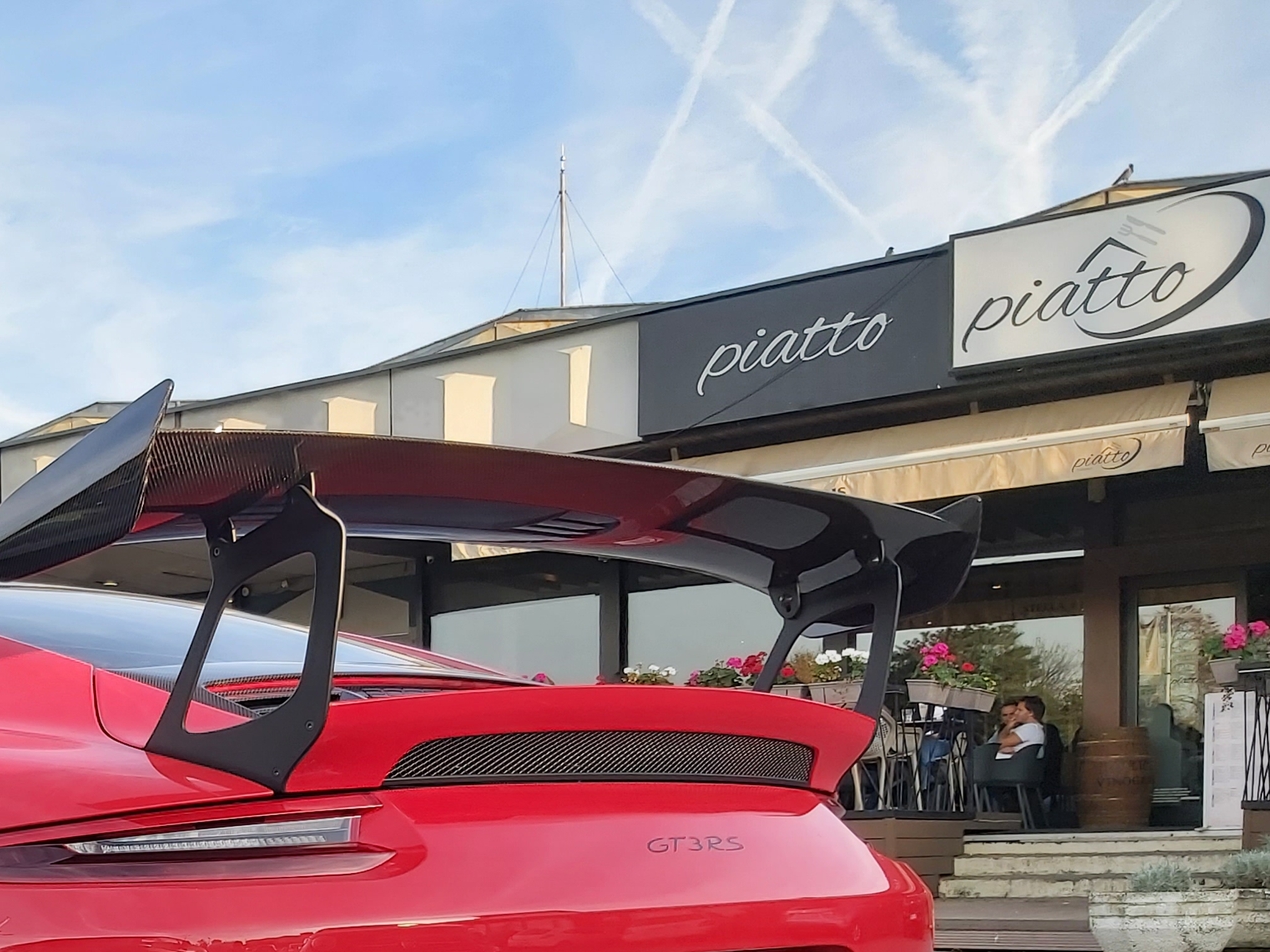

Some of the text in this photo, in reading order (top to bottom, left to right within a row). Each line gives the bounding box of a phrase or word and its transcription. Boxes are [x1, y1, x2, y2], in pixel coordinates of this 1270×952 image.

[961, 260, 1195, 352] piatto
[696, 312, 893, 395] piatto
[1071, 448, 1131, 472] piatto
